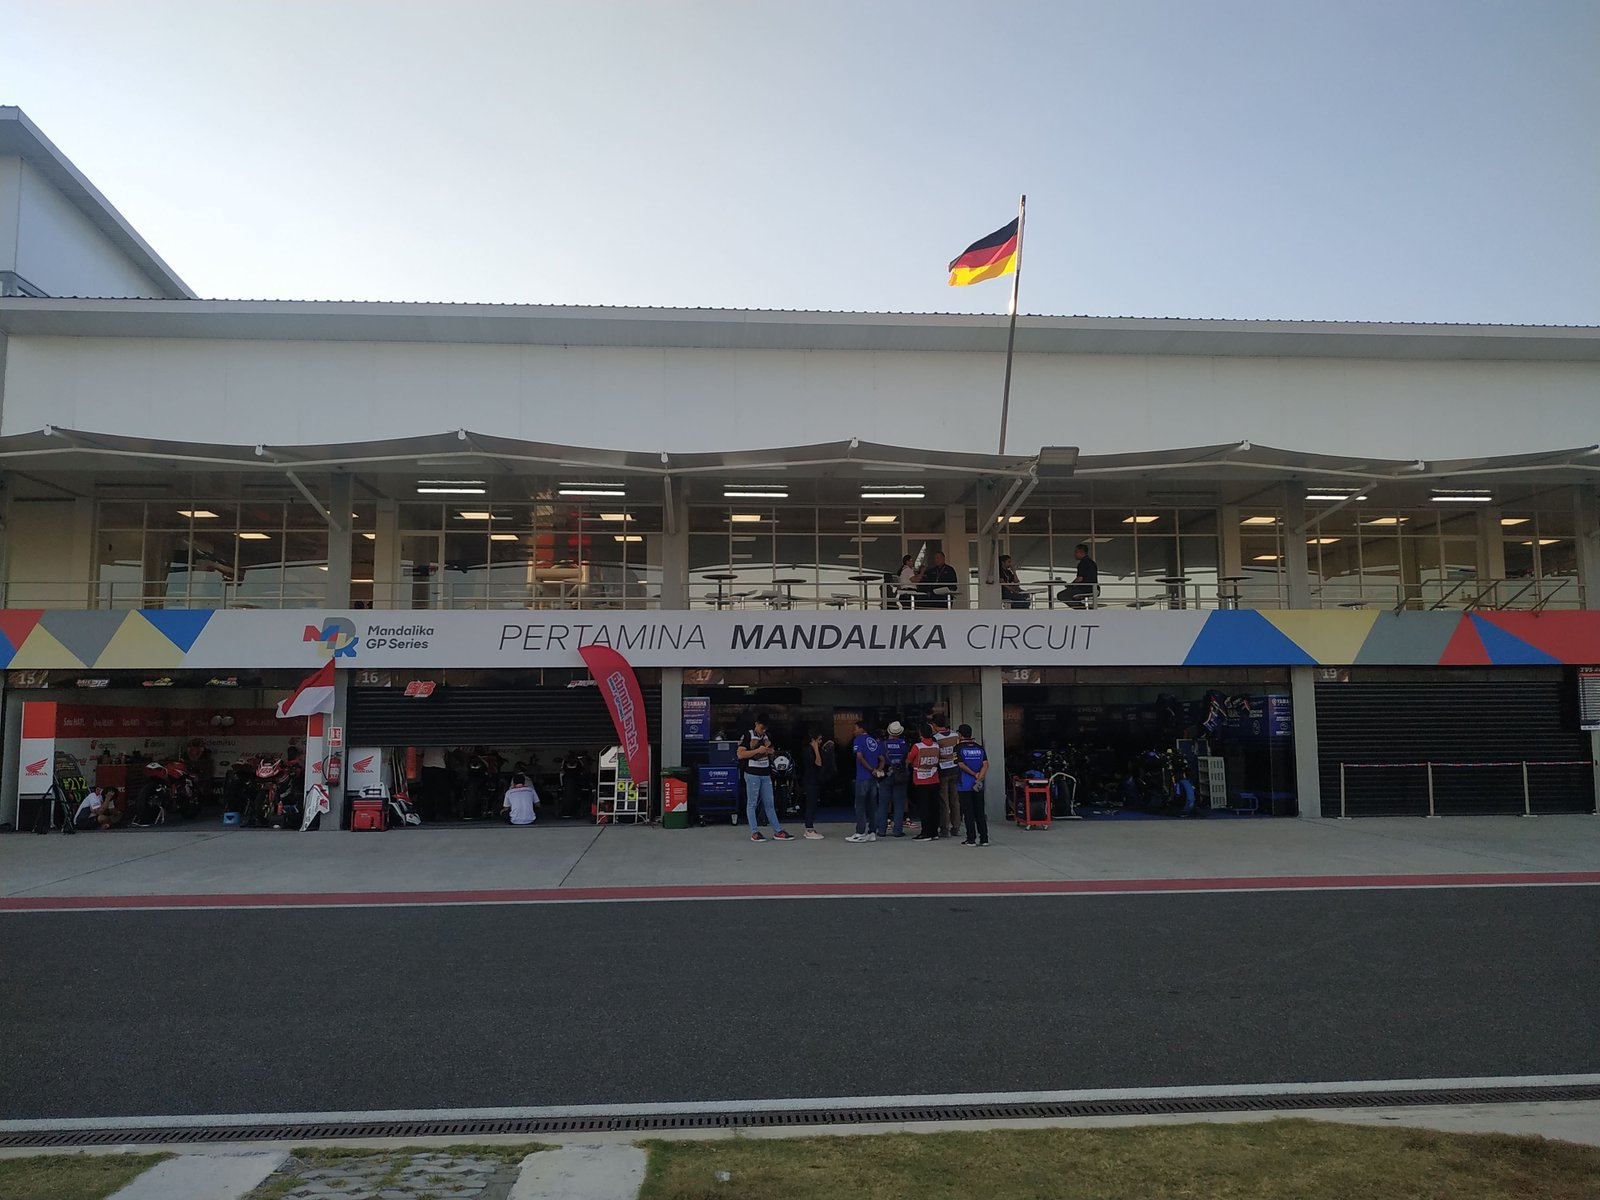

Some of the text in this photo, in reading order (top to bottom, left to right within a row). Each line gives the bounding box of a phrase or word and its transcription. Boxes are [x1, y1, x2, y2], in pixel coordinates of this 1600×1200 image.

[367, 625, 434, 636] Mandalika
[499, 624, 1100, 650] PERTAMINA MANDALIKA CIRCUIT
[366, 638, 429, 649] GP Series
[18, 673, 35, 685] 15
[362, 672, 378, 683] 16
[696, 669, 712, 681] 17
[1013, 669, 1030, 680] 18
[1322, 668, 1337, 679] 19
